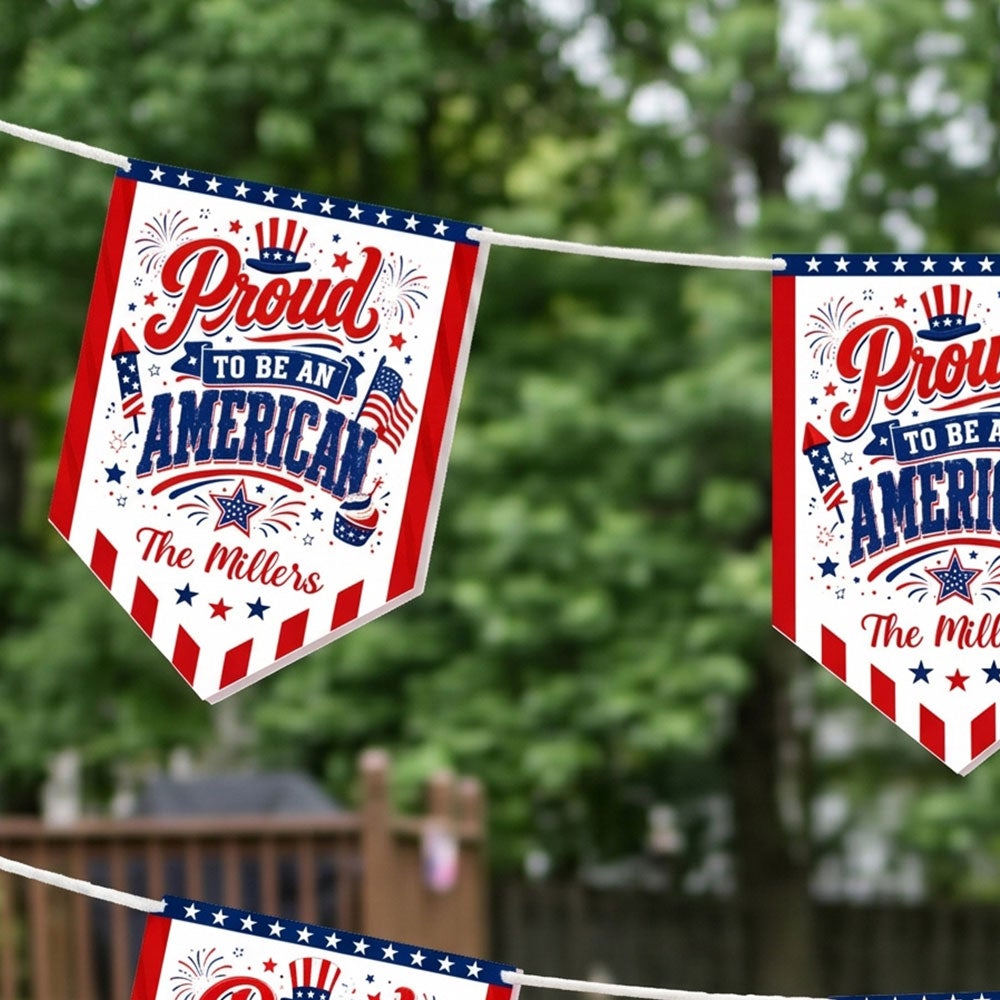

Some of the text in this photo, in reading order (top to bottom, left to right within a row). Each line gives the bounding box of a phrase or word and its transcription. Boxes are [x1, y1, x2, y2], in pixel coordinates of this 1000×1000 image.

[143, 238, 382, 354] Proud
[213, 354, 336, 390] TO BE AN
[137, 390, 379, 501] AMERICAN
[903, 428, 937, 454] TO
[945, 421, 981, 448] BE
[136, 526, 323, 594] The Millers
[861, 613, 923, 648] The
